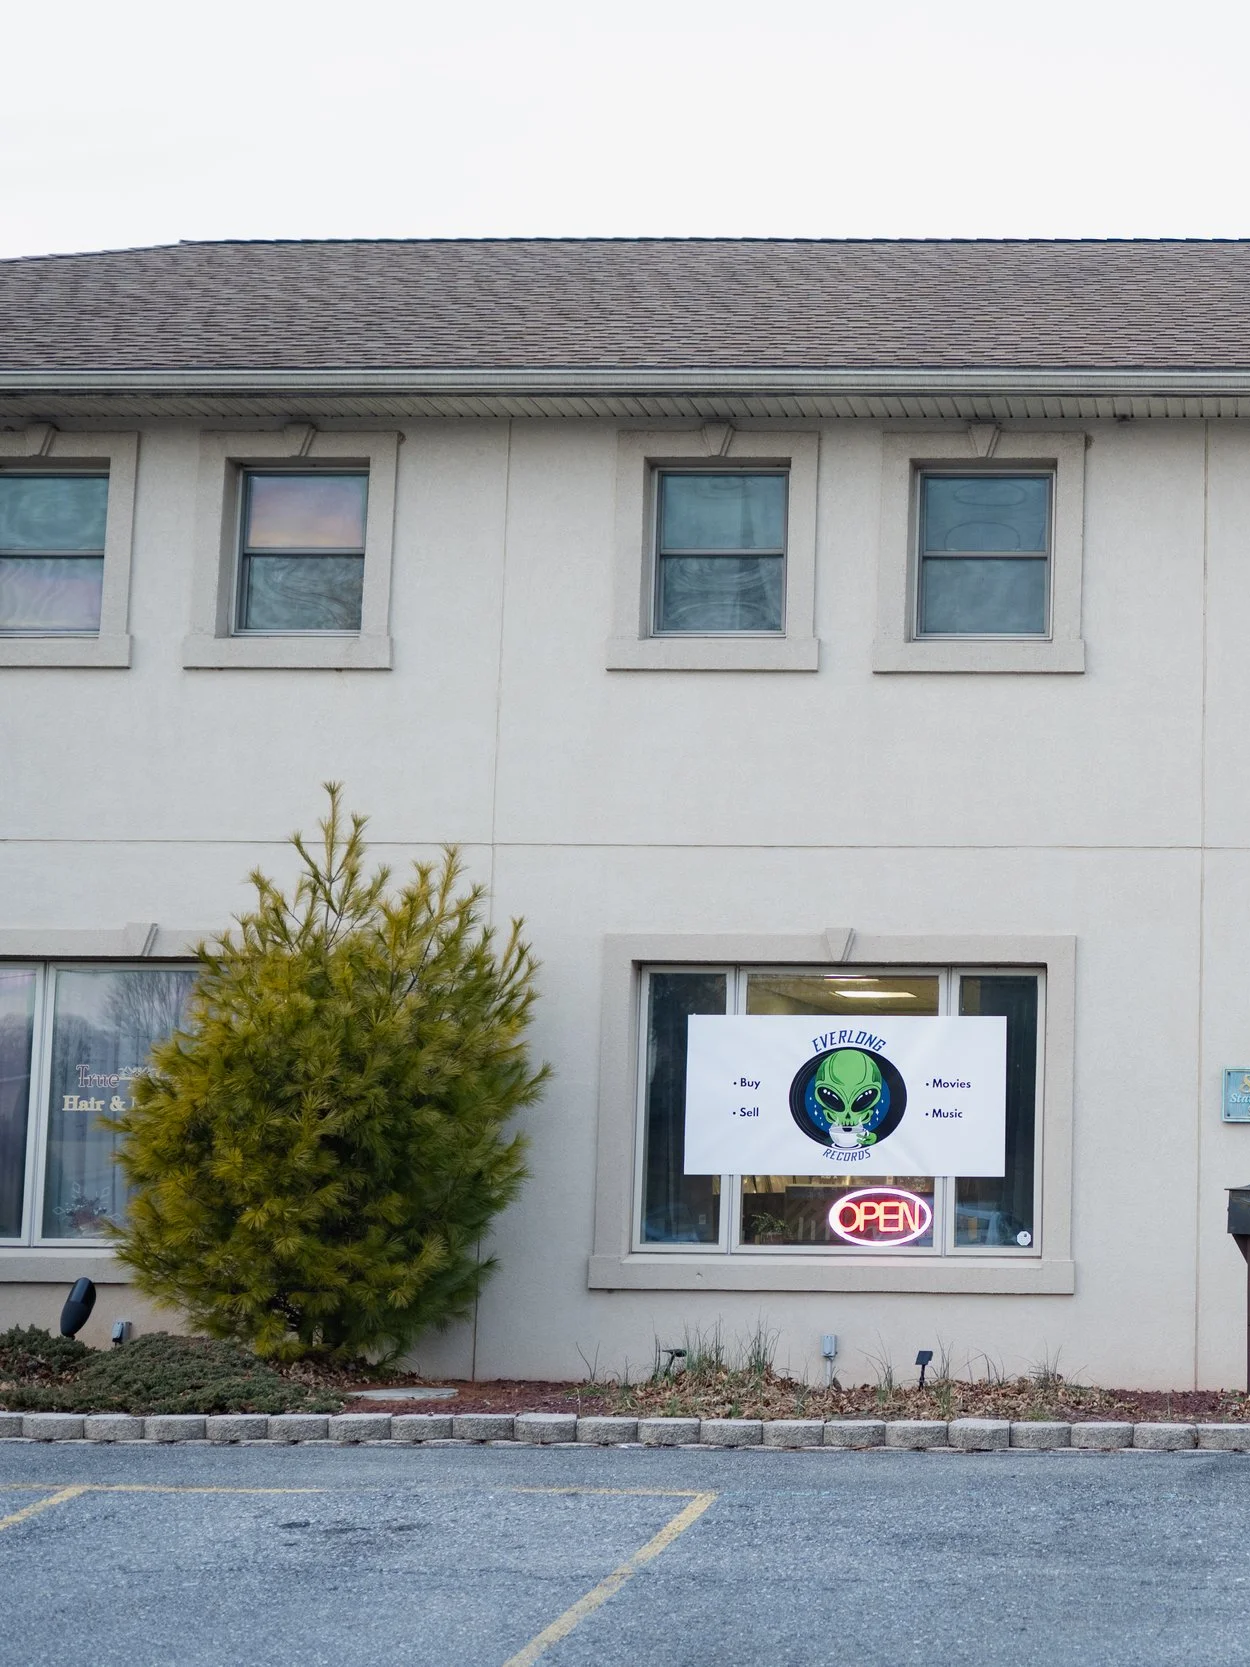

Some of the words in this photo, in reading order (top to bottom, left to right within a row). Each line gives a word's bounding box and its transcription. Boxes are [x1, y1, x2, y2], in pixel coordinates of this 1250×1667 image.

[812, 1030, 886, 1052] EVERLONG
[76, 1064, 120, 1088] True
[932, 1078, 971, 1088] Movies
[740, 1077, 761, 1090] Buy
[62, 1095, 105, 1111] Hair
[109, 1095, 126, 1111] &
[740, 1107, 759, 1117] Sell
[932, 1108, 963, 1118] Music
[822, 1148, 871, 1162] RECORDS
[838, 1201, 920, 1232] OPEN
